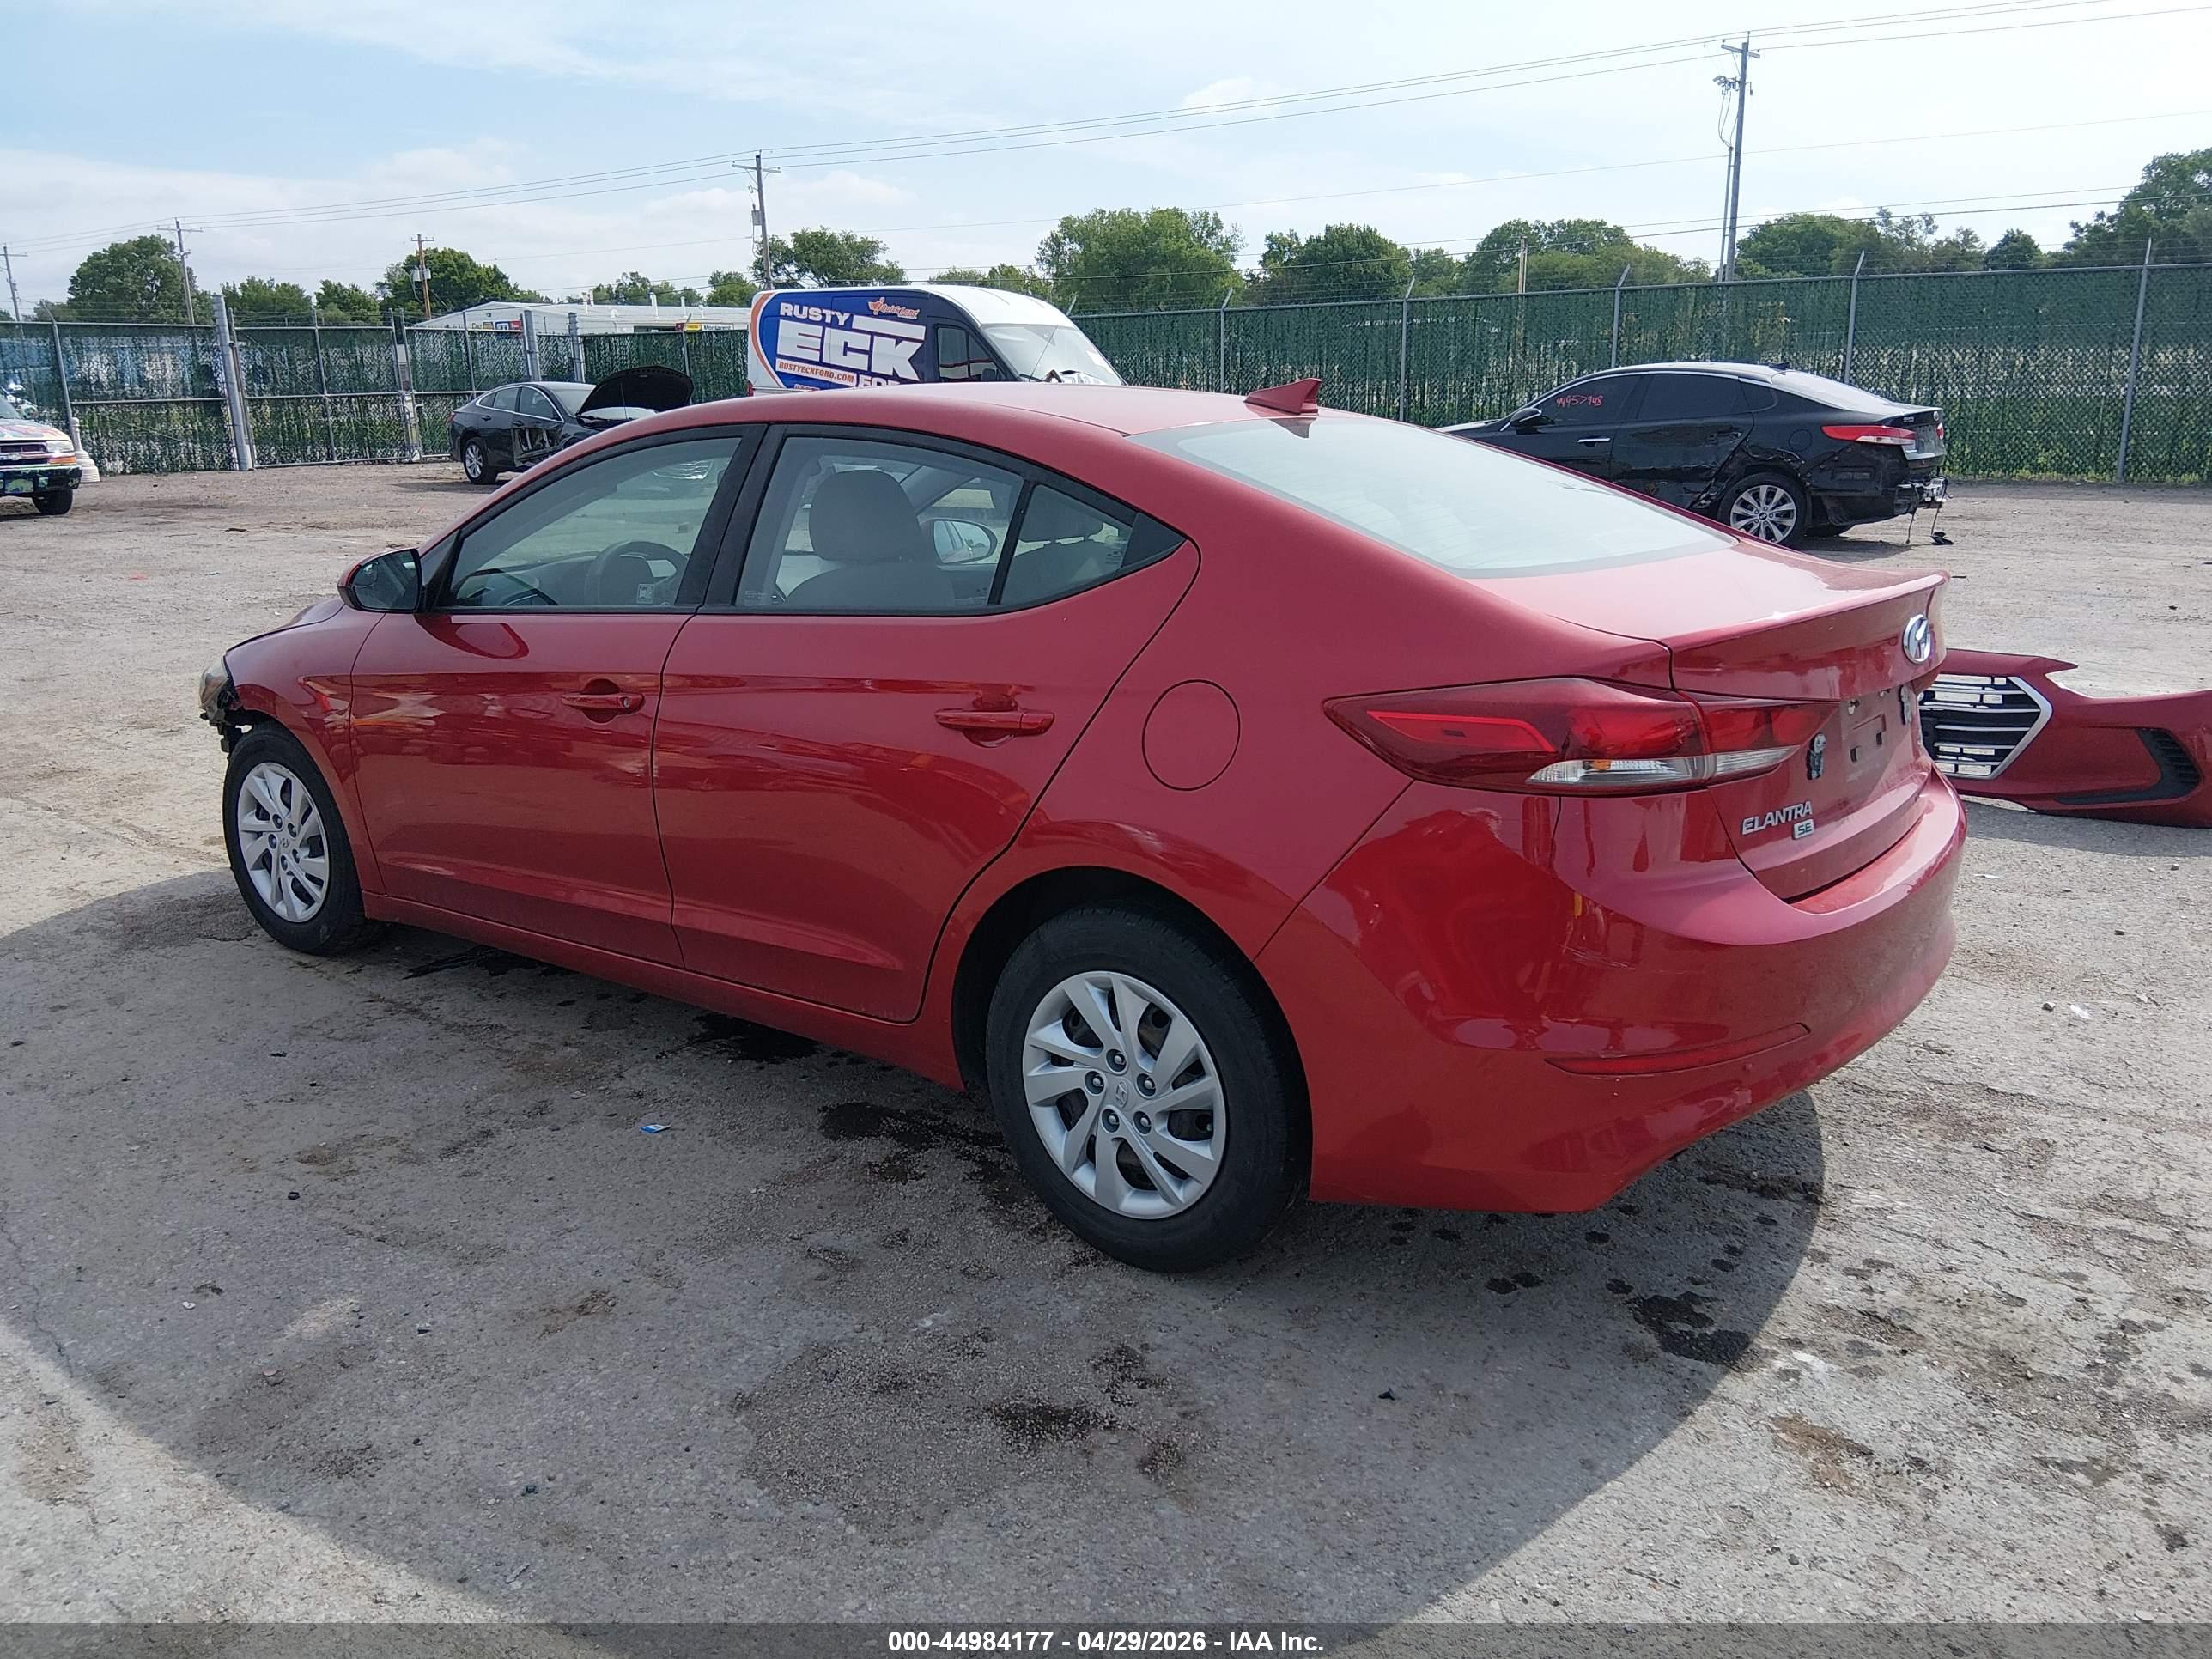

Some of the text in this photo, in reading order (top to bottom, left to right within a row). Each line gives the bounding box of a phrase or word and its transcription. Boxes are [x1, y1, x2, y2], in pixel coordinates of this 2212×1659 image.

[780, 302, 851, 326] RUSTY
[776, 319, 924, 382] ECK
[778, 362, 854, 383] RUSTYECKFORD.COM
[1741, 800, 1813, 836] ELANTRA
[1797, 822, 1812, 836] SE
